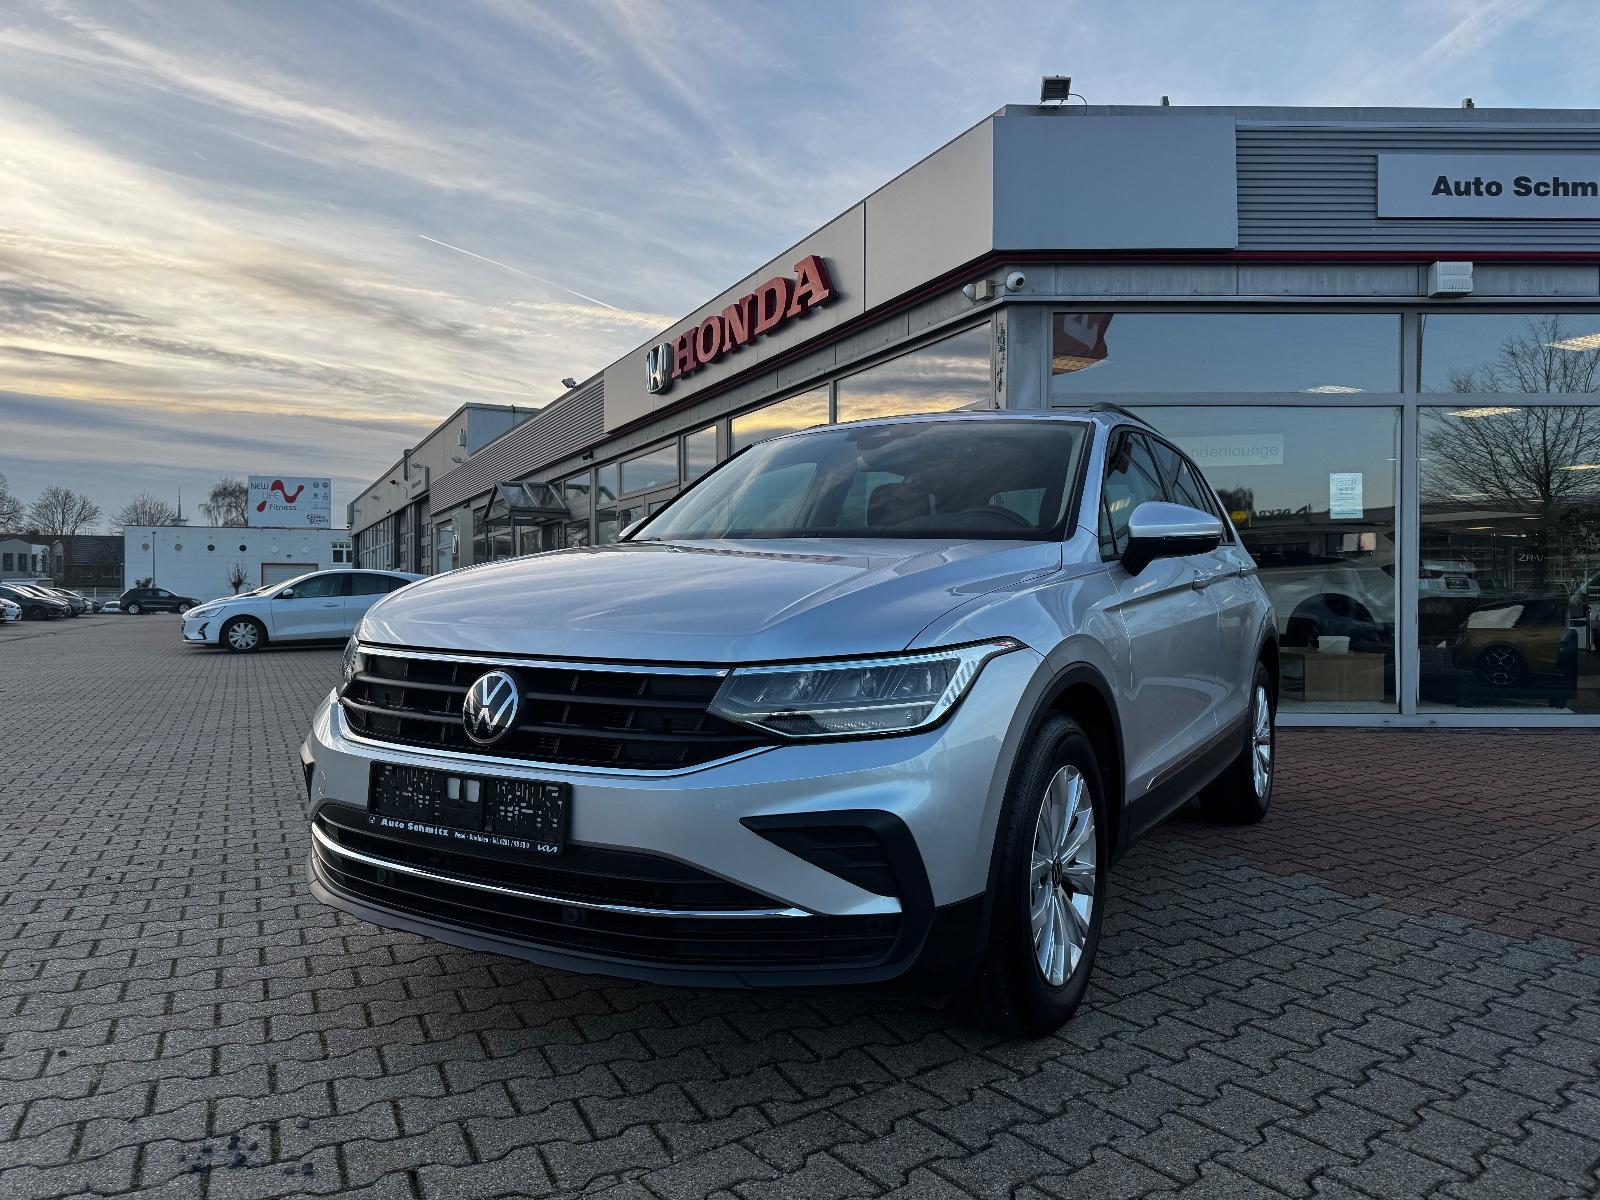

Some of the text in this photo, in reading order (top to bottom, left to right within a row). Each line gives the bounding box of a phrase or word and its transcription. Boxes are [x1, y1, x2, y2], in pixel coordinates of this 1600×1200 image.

[1431, 175, 1599, 197] Auto Schm
[672, 255, 834, 379] HONDA
[1190, 441, 1281, 459] ndenlounge
[269, 503, 297, 511] Fitness
[380, 818, 405, 829] Auto
[407, 822, 449, 837] Schmitz
